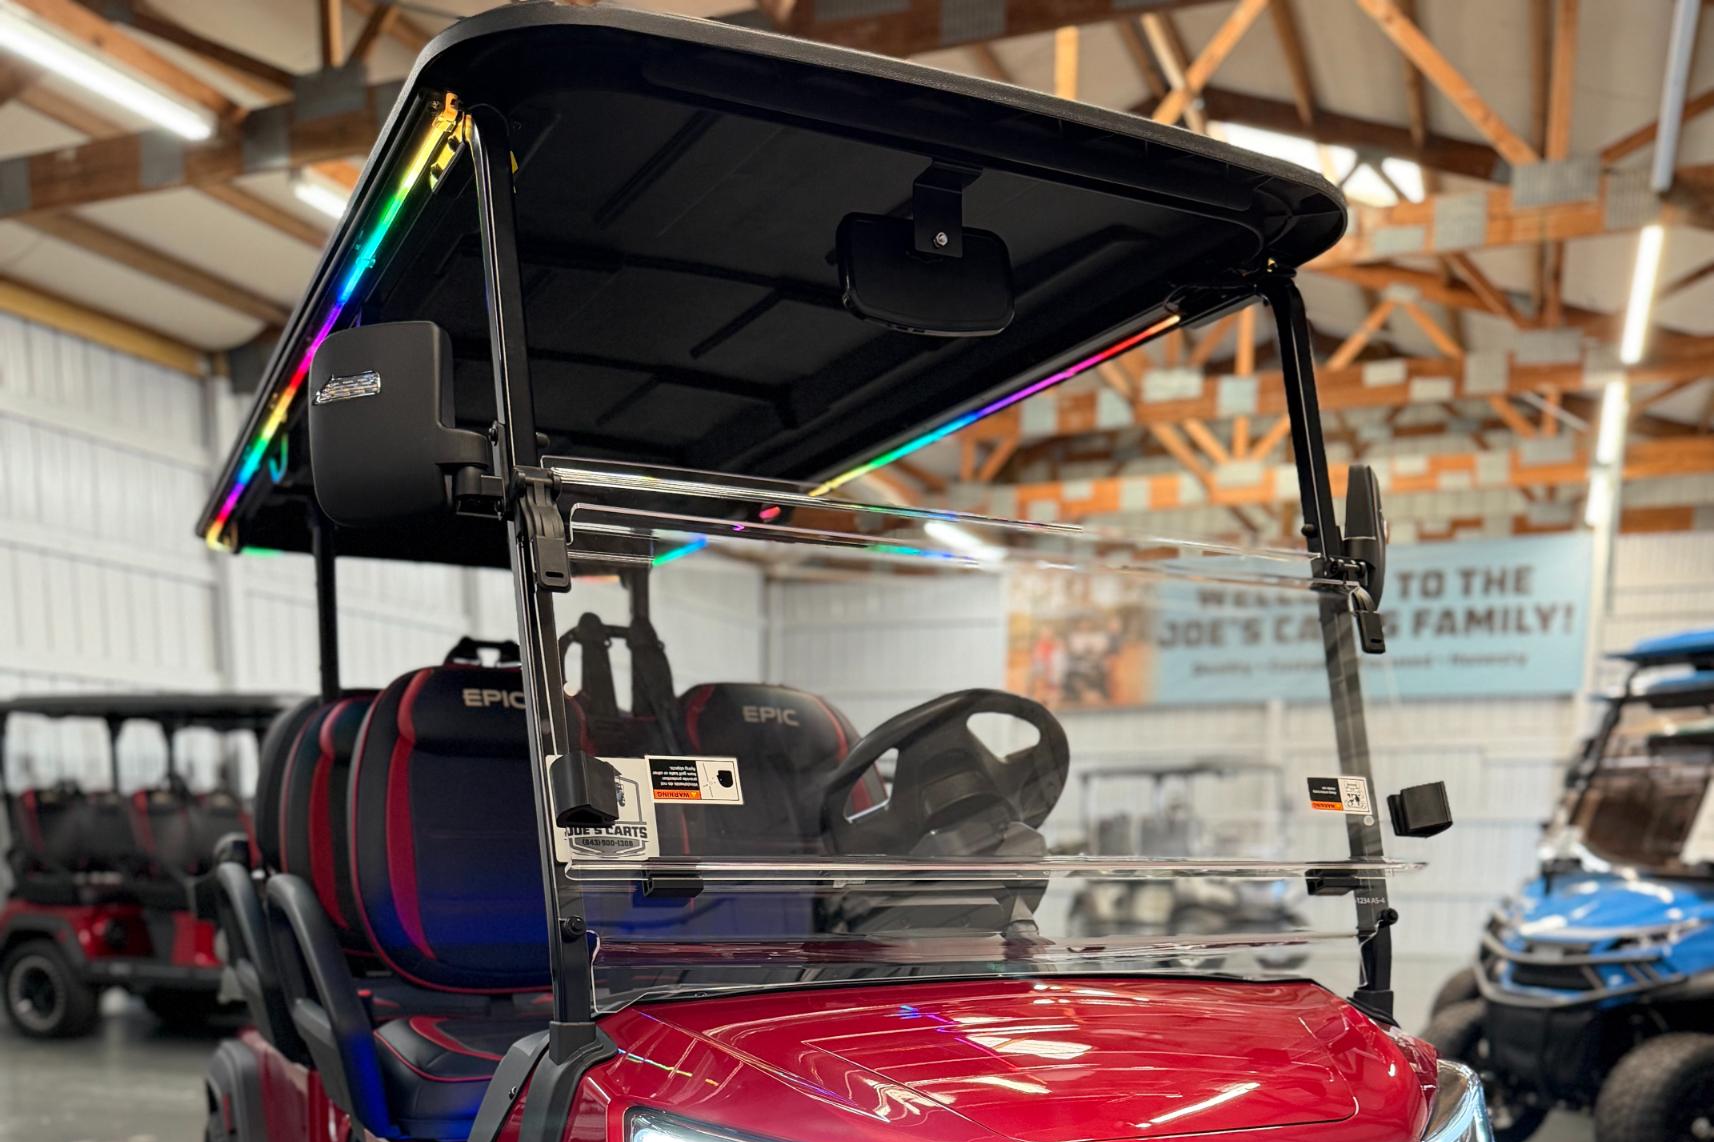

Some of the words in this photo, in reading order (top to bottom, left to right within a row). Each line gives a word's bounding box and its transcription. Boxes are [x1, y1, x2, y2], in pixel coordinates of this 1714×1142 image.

[1396, 568, 1445, 601] TO
[1456, 565, 1535, 597] THE
[1159, 615, 1262, 647] JOE'S
[1412, 602, 1575, 638] FAMILY!
[463, 687, 527, 710] EPIC
[743, 706, 800, 726] EPIC
[605, 825, 648, 838] CARTS
